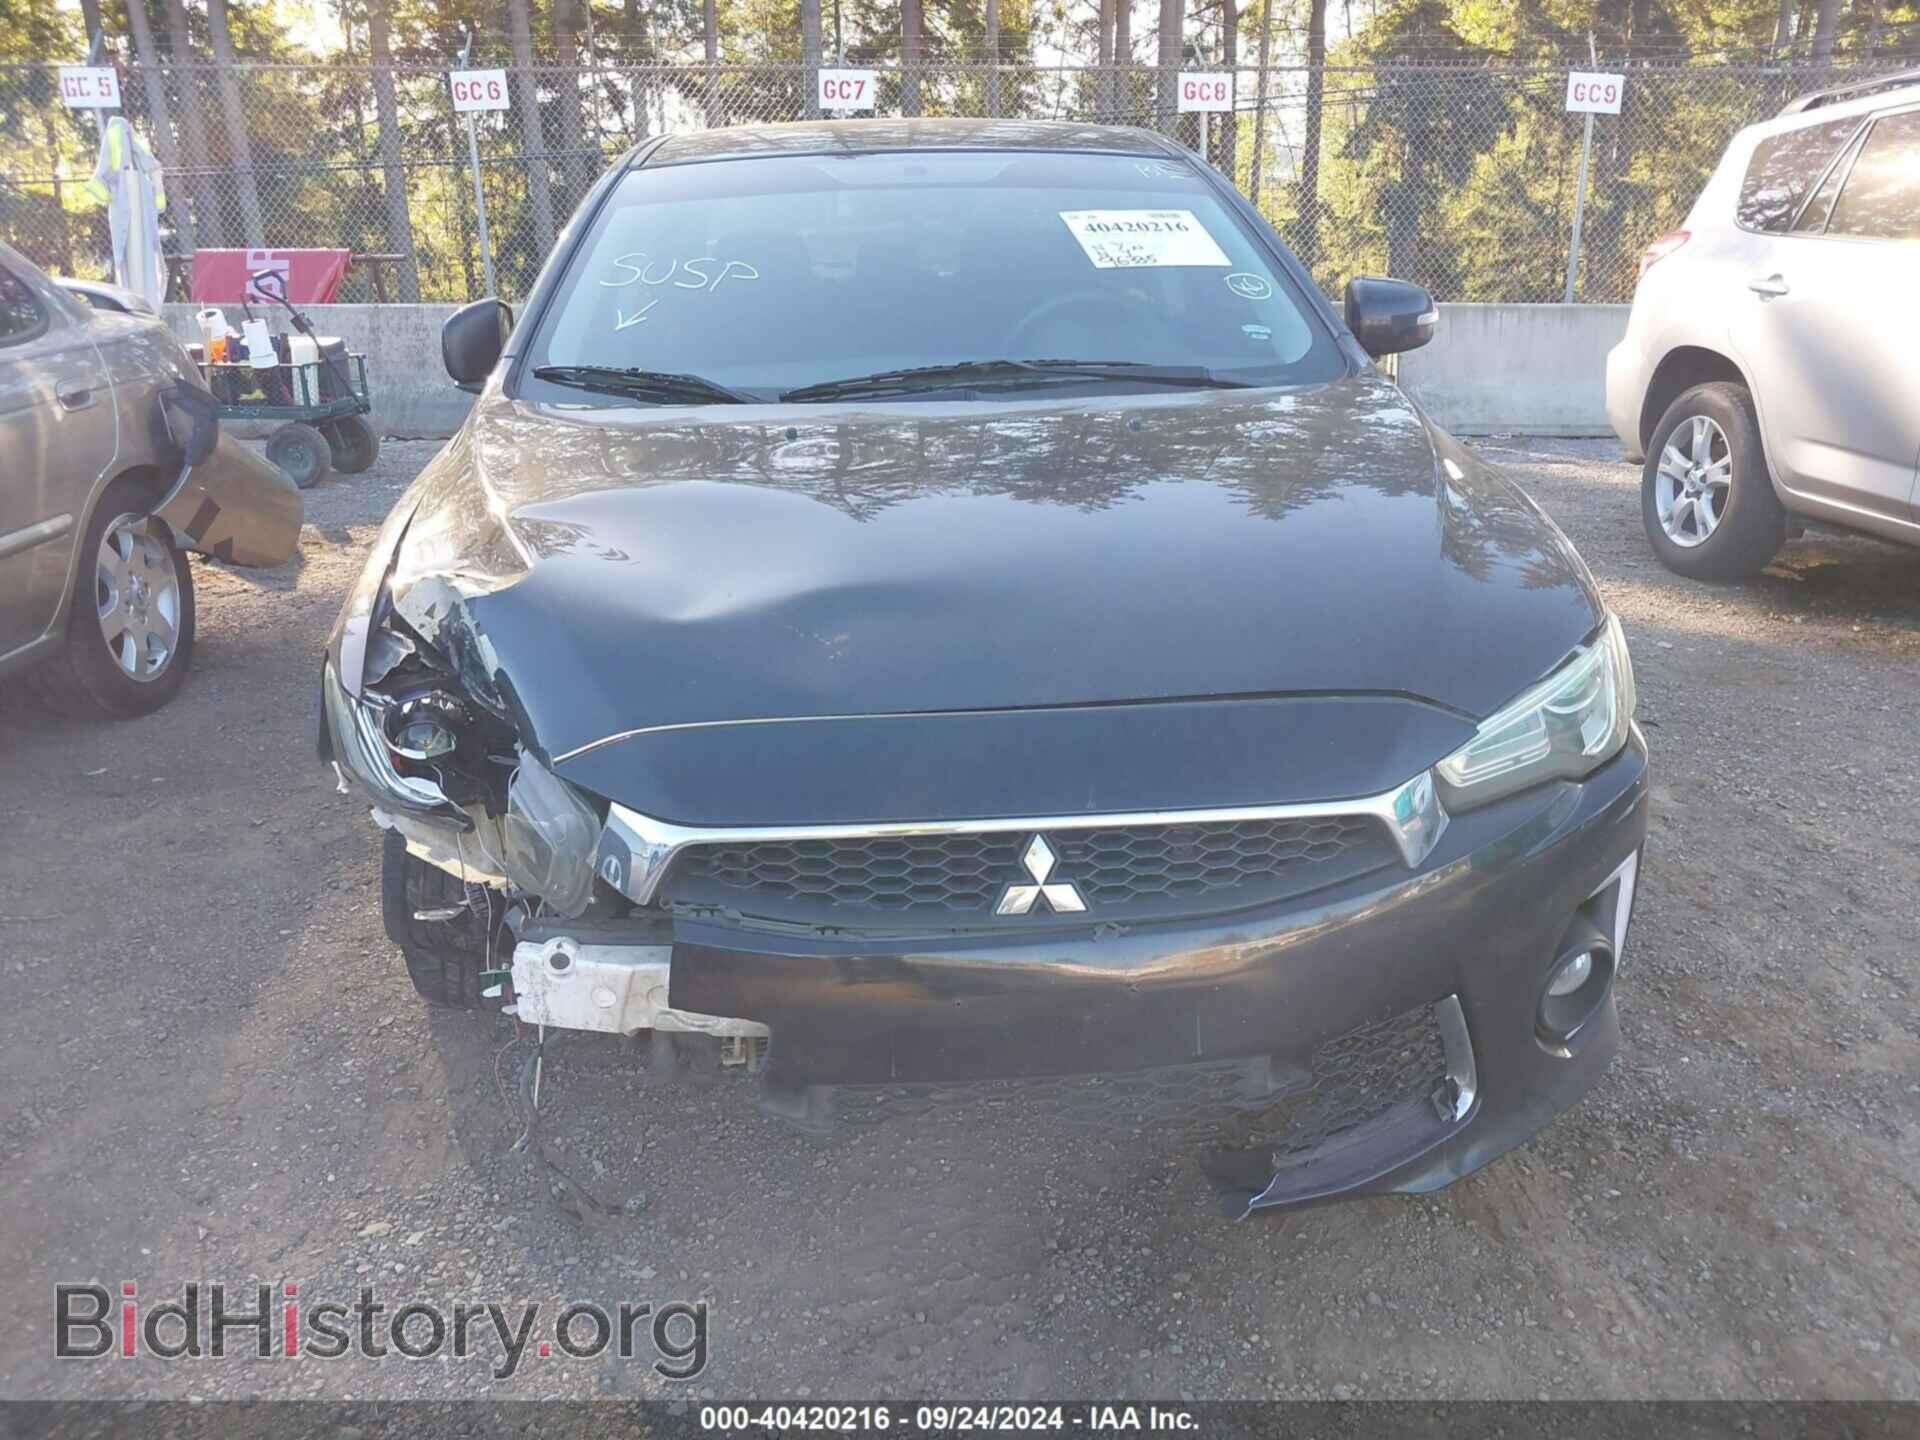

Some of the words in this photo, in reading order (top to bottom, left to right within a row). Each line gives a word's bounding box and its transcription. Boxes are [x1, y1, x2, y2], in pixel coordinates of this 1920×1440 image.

[823, 79, 865, 100] GC7
[1184, 81, 1226, 101] GC8
[1574, 83, 1617, 103] GC9
[1085, 221, 1190, 233] 40420216
[600, 252, 759, 292] SUSP
